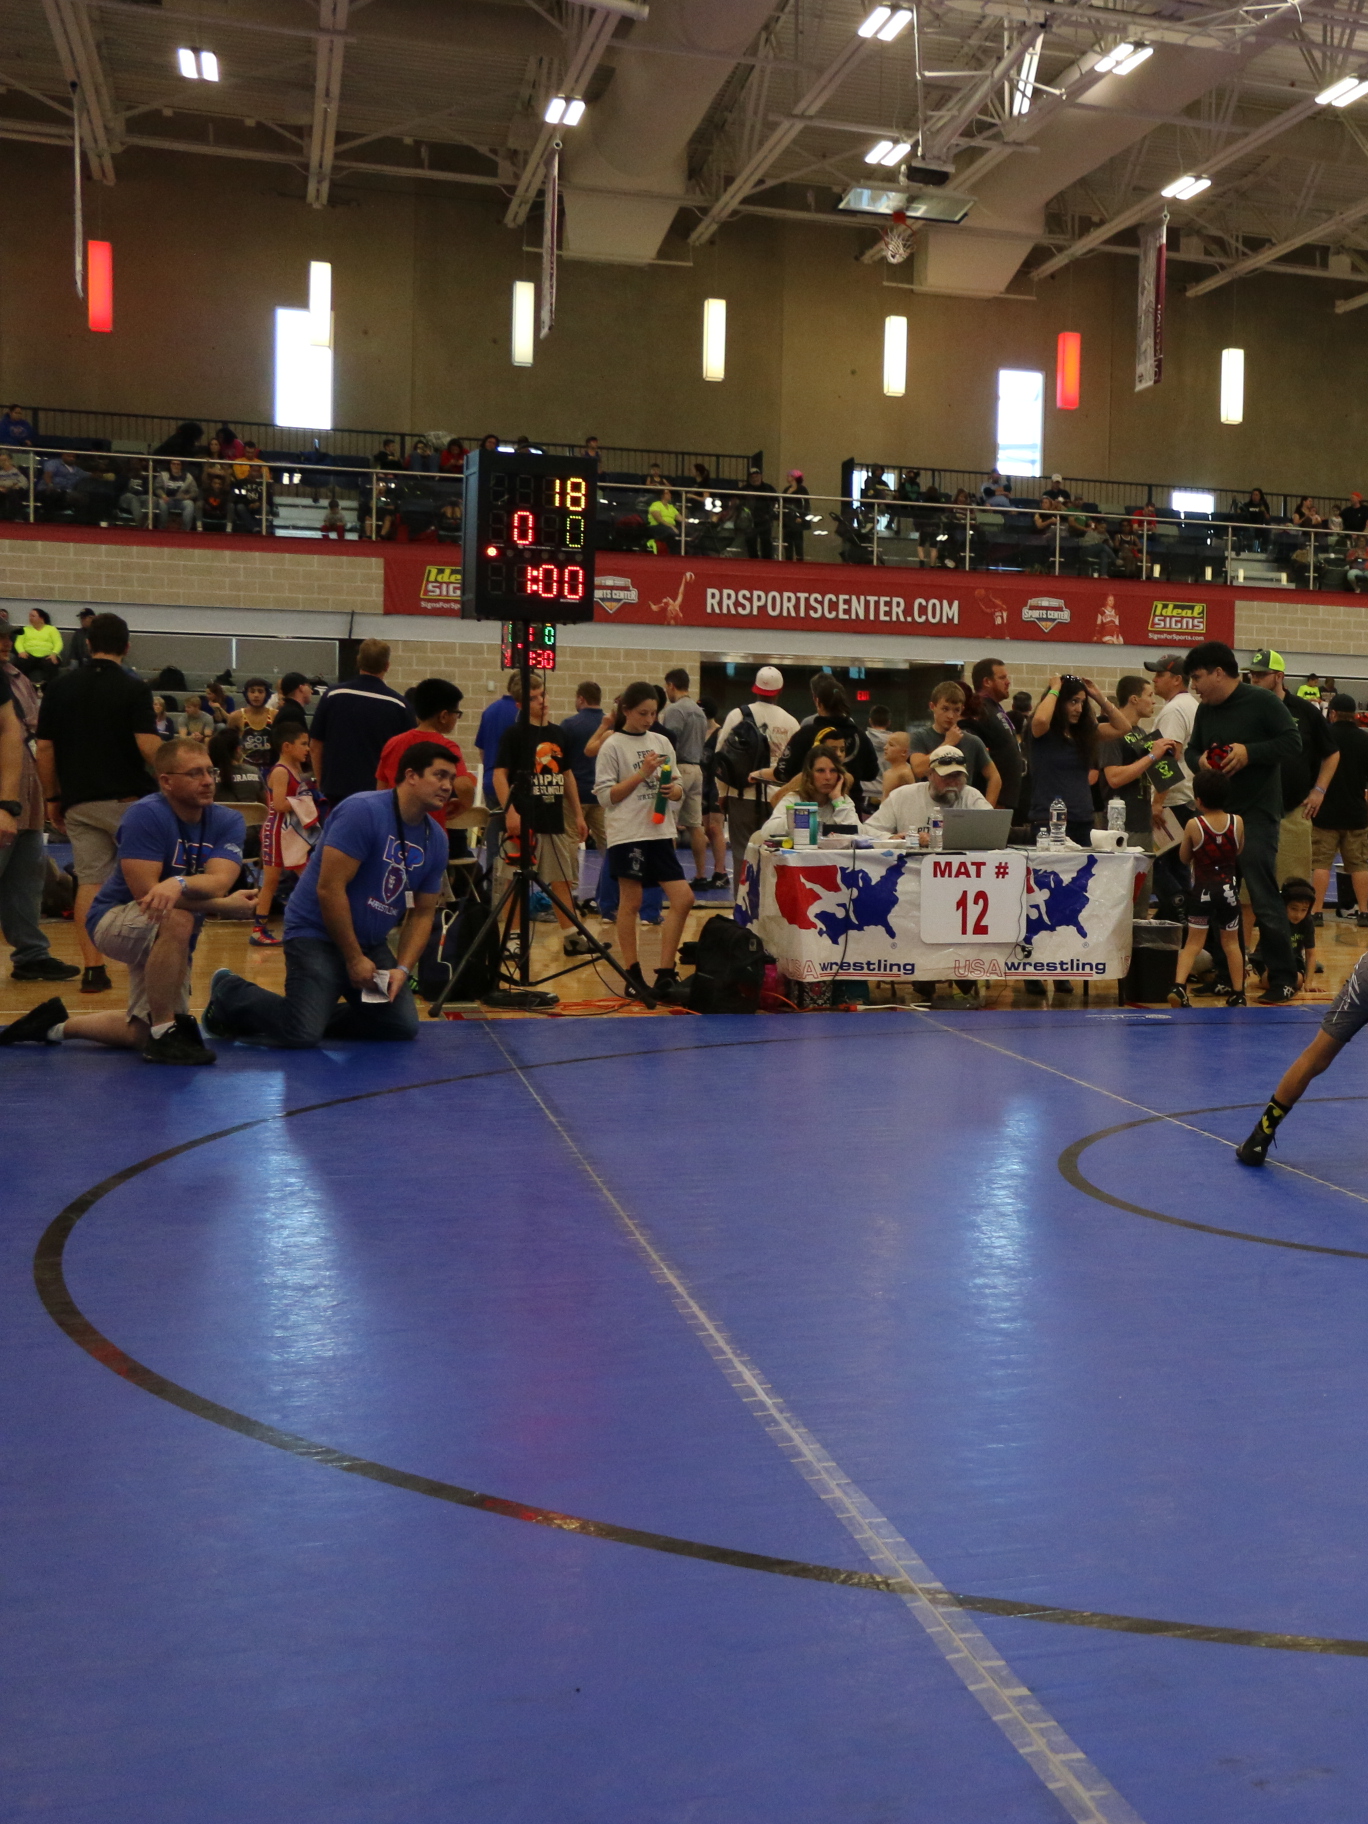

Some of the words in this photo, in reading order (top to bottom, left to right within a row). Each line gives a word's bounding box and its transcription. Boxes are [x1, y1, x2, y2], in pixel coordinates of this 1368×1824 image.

[554, 477, 586, 511] 18
[513, 511, 533, 545] 0
[566, 515, 585, 548] 0
[426, 582, 461, 596] SIG
[527, 564, 584, 599] 1:00
[612, 590, 636, 599] CENTER
[421, 601, 461, 610] SignsForSp
[705, 587, 960, 625] RRSPORTSCENTER.COM
[1155, 603, 1204, 617] Ideal
[1024, 609, 1046, 619] SPORTS
[1047, 610, 1068, 620] CENTER
[1148, 633, 1205, 642] SignsForSports.com
[247, 735, 268, 743] GOT
[932, 861, 986, 878] MAT
[995, 861, 1010, 879] #
[955, 890, 989, 936] 12
[819, 959, 915, 975] wrestling
[953, 958, 1003, 978] USA
[1004, 959, 1107, 975] wrestling
